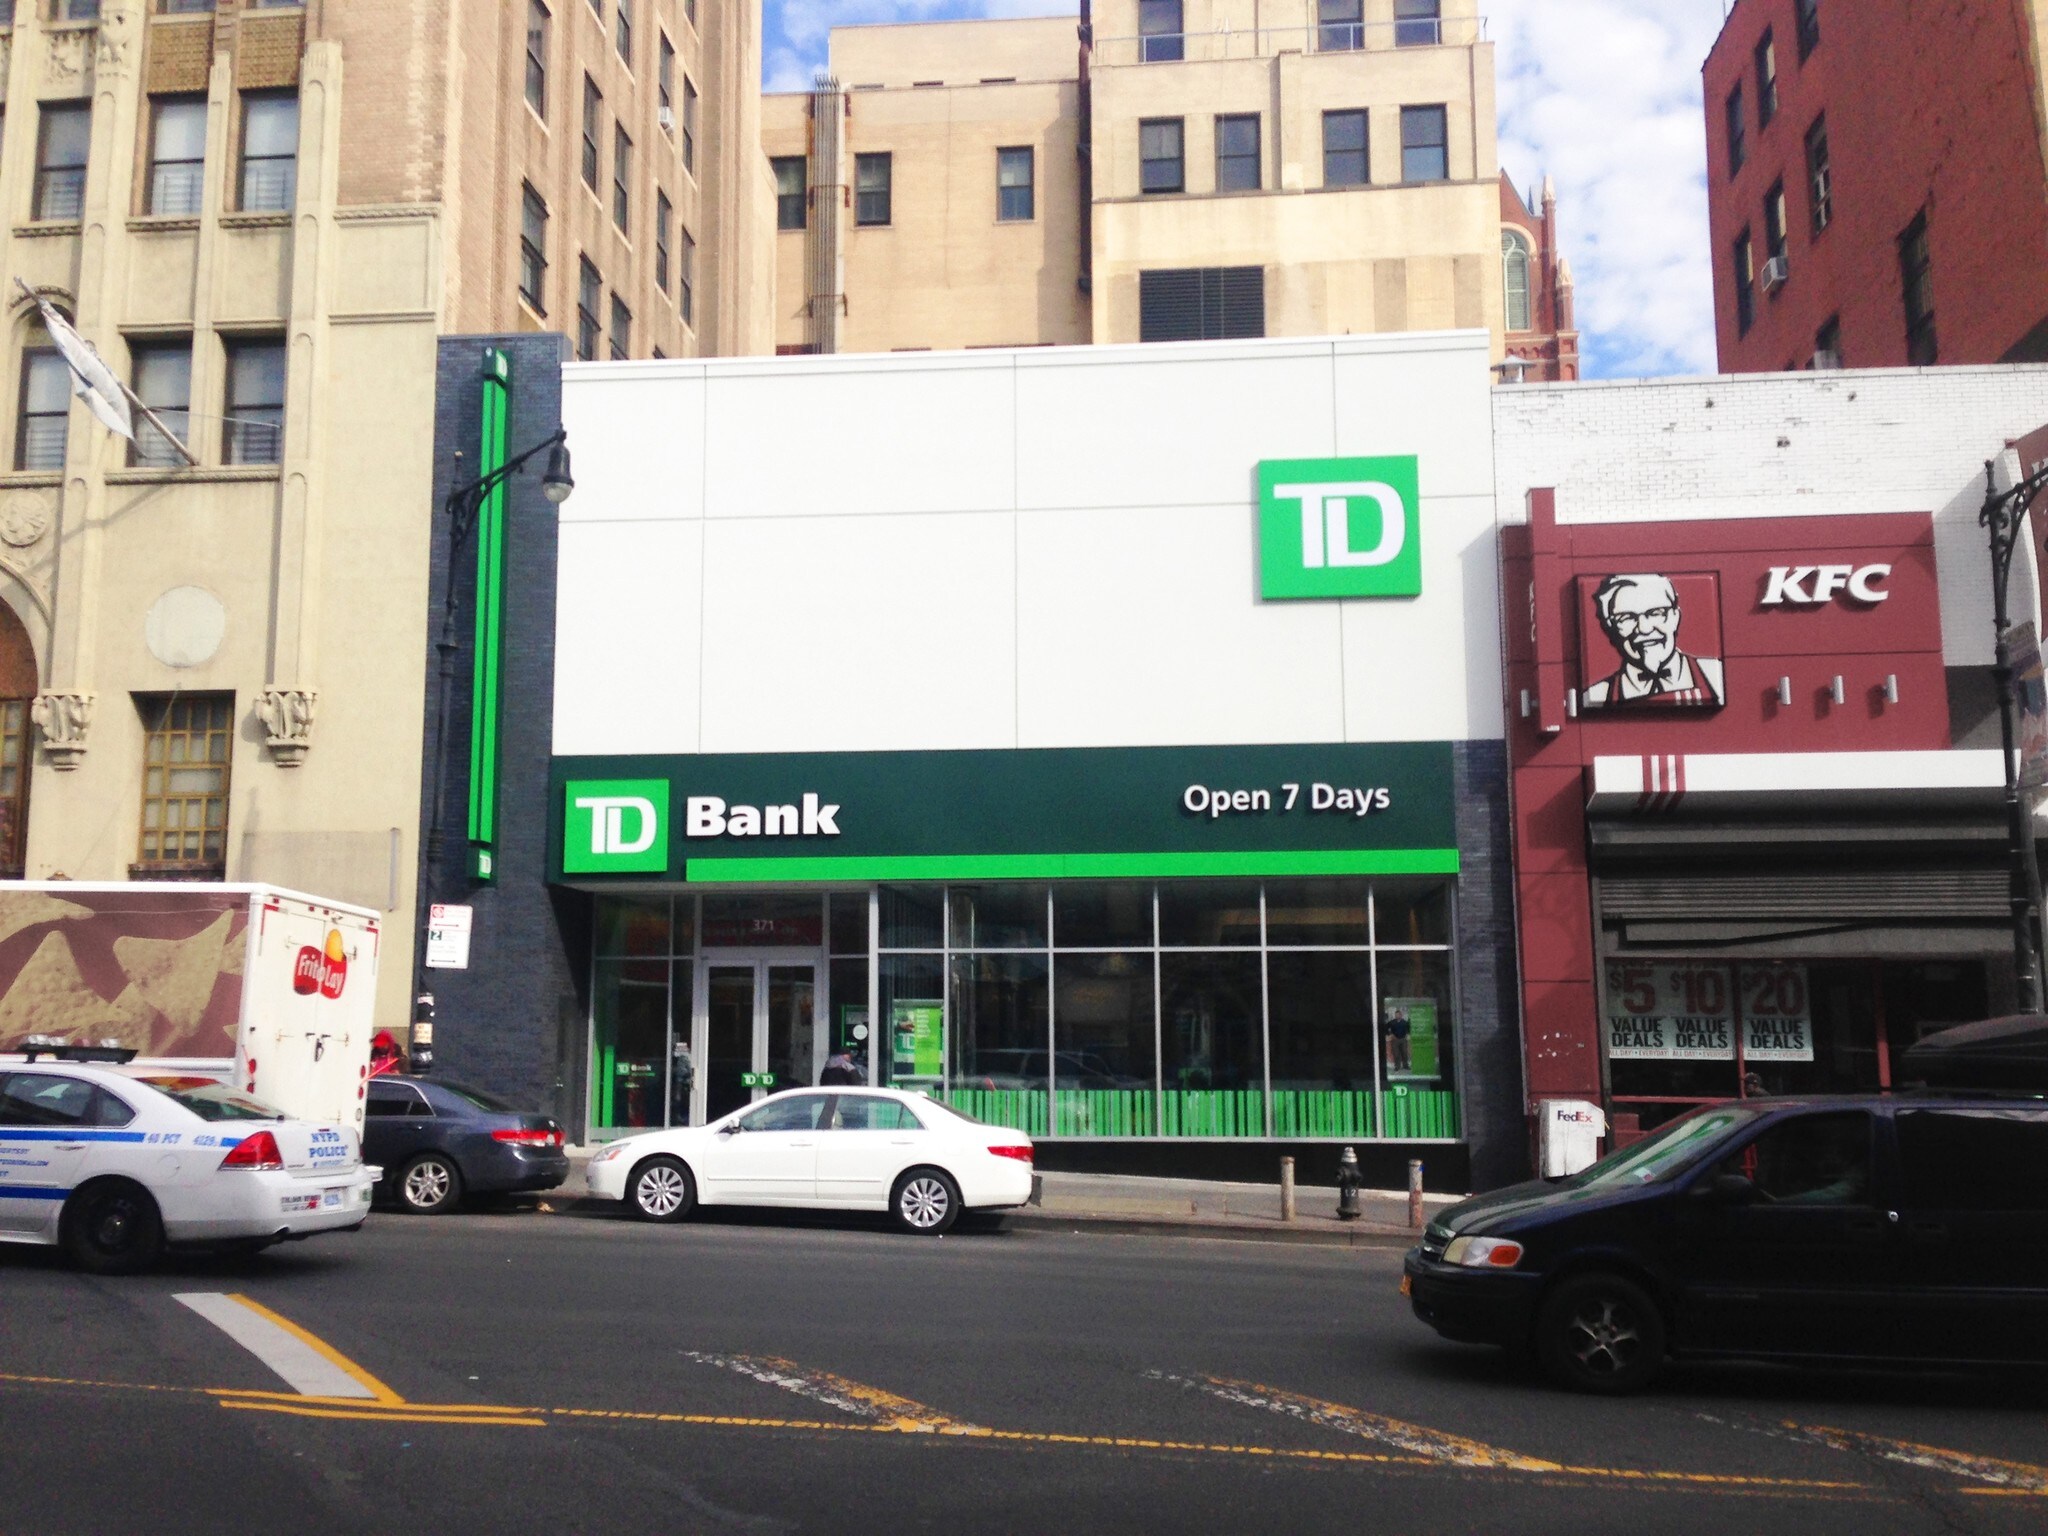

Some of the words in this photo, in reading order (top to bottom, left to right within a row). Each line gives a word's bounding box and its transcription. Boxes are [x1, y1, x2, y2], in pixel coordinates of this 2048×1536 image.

[1273, 481, 1406, 569] TD
[1760, 563, 1892, 604] KFC
[1183, 784, 1271, 818] Open
[1281, 783, 1300, 810] 7
[1311, 782, 1391, 816] Days
[575, 796, 657, 854] TD
[686, 792, 841, 837] Bank
[752, 919, 774, 931] 371
[325, 964, 344, 995] Lay
[1609, 968, 1656, 1014] $5
[1670, 968, 1726, 1015] $10
[1611, 1018, 1663, 1033] VALUE
[1675, 1018, 1728, 1034] VALUE
[1750, 1019, 1804, 1035] VALUE
[1611, 1032, 1664, 1048] DEALS
[1676, 1033, 1728, 1049] DEALS
[1750, 1034, 1805, 1049] DEALS
[743, 1074, 757, 1085] TD
[761, 1074, 774, 1085] TD
[1393, 1085, 1408, 1096] TD
[1557, 1110, 1593, 1122] FedEx
[311, 1132, 340, 1143] NYPD
[309, 1145, 346, 1158] POLICE
